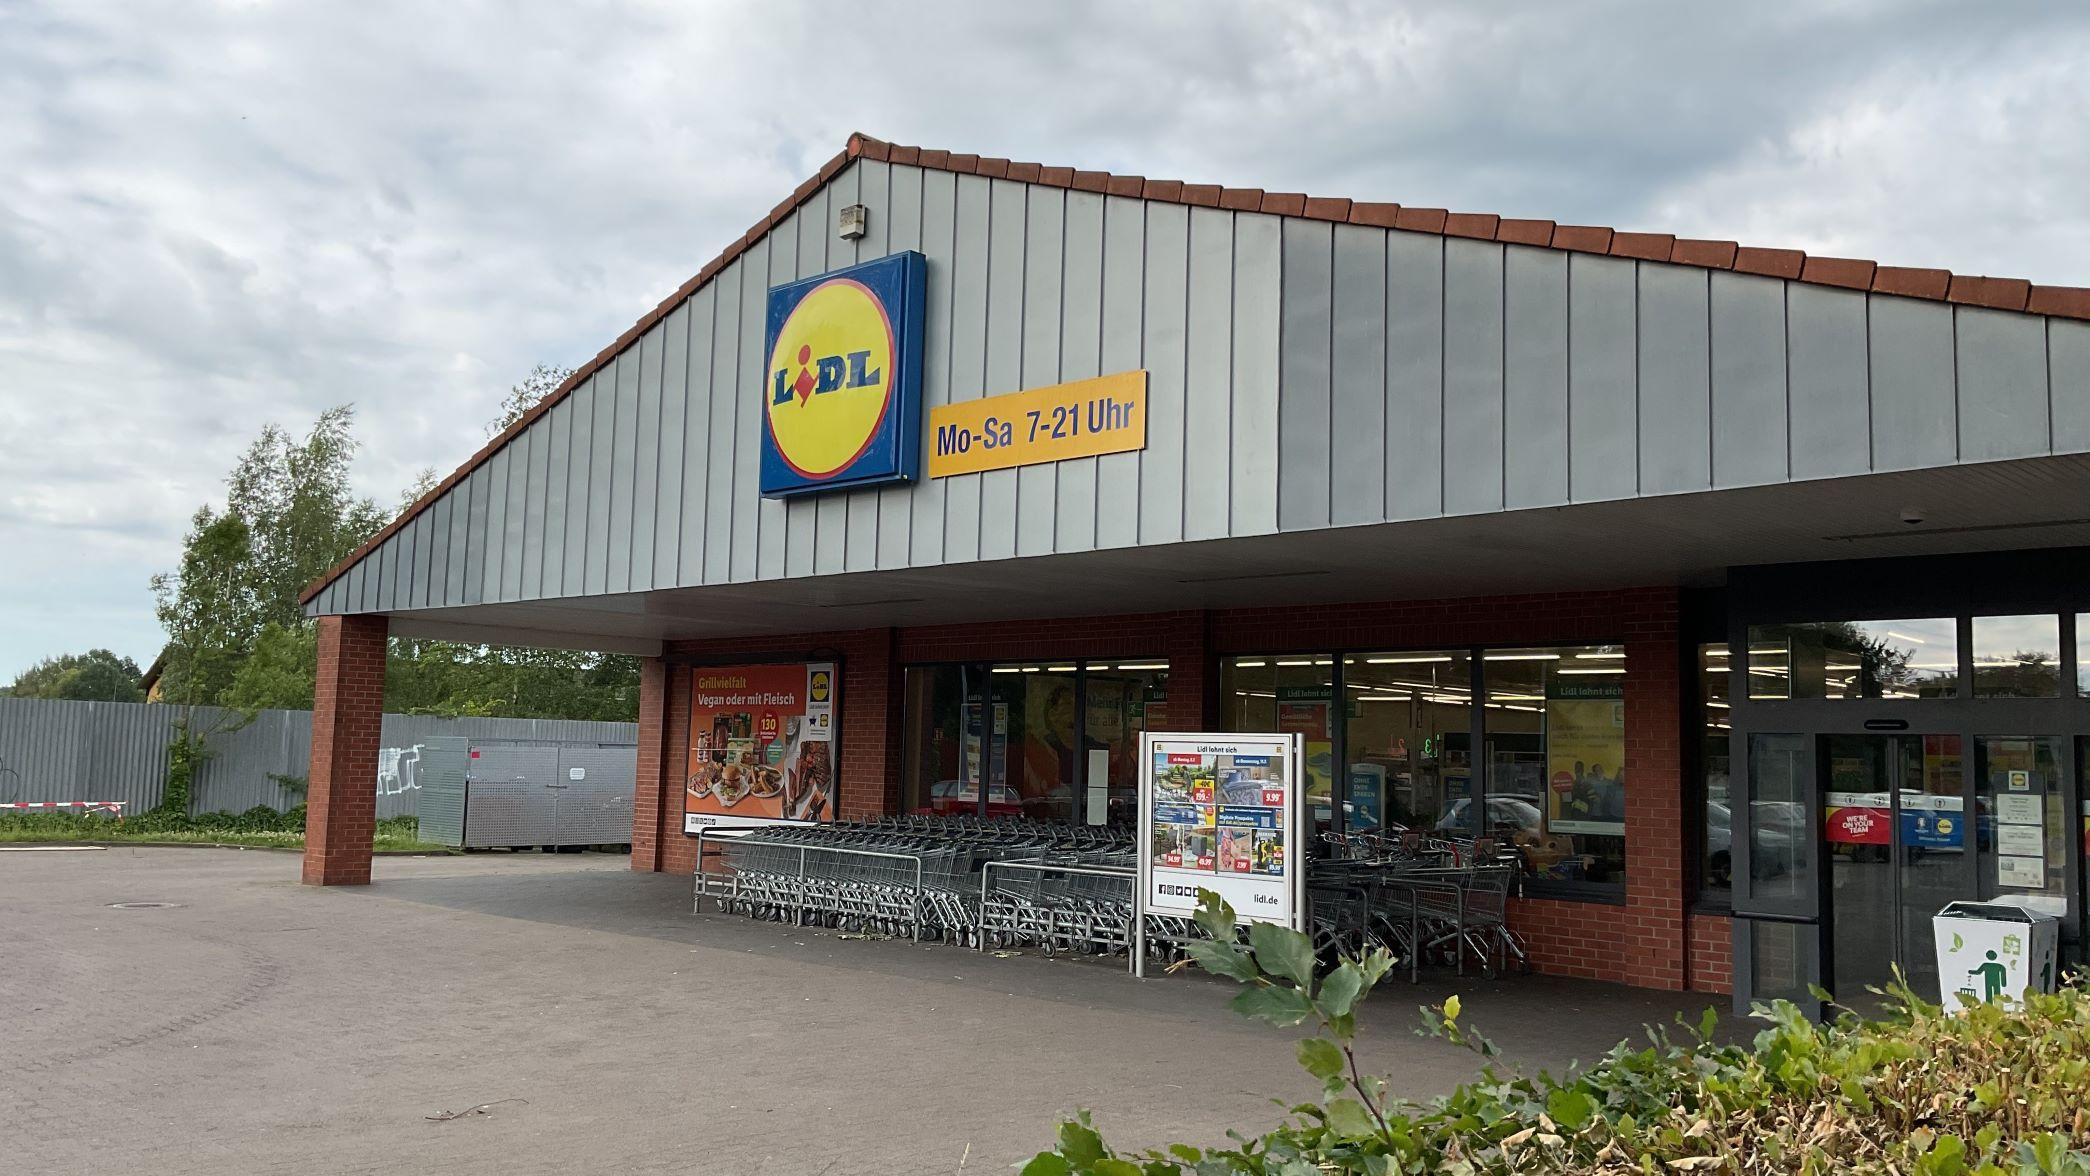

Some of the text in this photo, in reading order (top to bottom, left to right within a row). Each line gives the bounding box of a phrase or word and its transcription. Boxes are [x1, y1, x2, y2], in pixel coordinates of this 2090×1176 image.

[937, 399, 1135, 457] Mo-Sa 7-21 Uhr
[699, 677, 746, 690] Grillvielfalt
[698, 692, 795, 708] Vegan oder mit Fleisch
[760, 718, 776, 731] 130
[1197, 745, 1238, 754] Lidl lohnt sich
[1842, 819, 1874, 829] ON YOUR
[1849, 826, 1869, 834] TEAM
[1254, 894, 1279, 905] lidl.de
